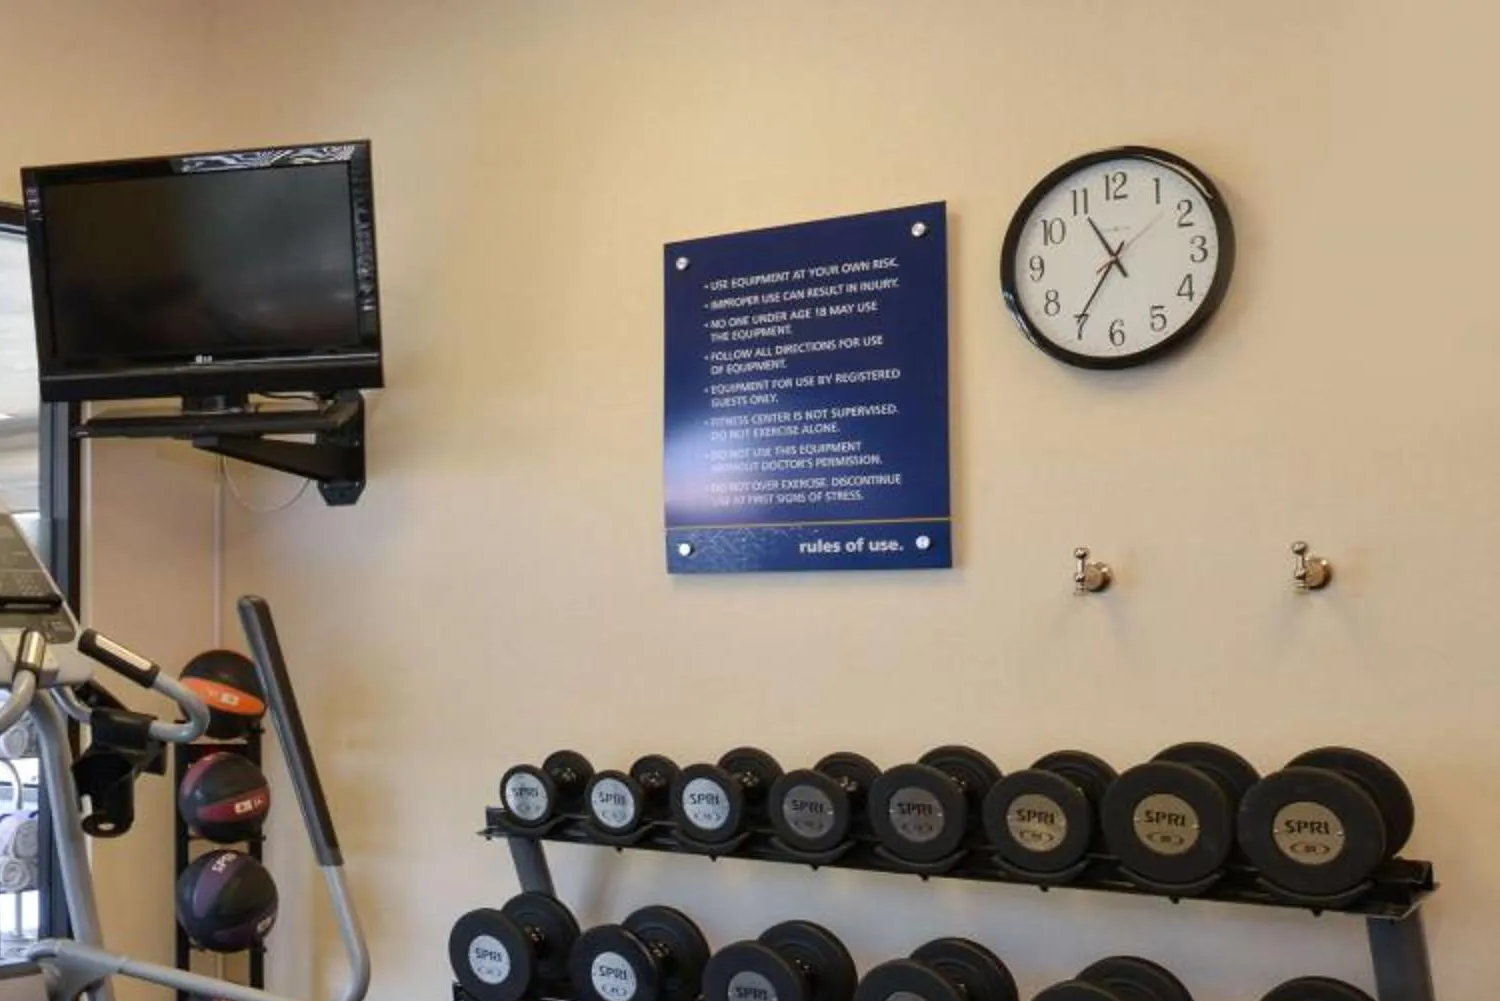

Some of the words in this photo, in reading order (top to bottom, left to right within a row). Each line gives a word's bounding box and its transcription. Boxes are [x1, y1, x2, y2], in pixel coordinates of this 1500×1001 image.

[1104, 171, 1128, 201] 12
[1153, 177, 1161, 204] 1
[1071, 187, 1088, 216] 11
[1177, 199, 1193, 228] 2
[1041, 217, 1066, 246] 10
[1190, 235, 1208, 263] 3
[710, 280, 728, 290] USE
[731, 271, 790, 288] EQUIPMENT
[792, 269, 805, 280] AT
[808, 265, 839, 277] YOUR
[841, 261, 870, 274] OWN
[1029, 255, 1044, 281] 9
[761, 292, 780, 304] USE
[783, 290, 805, 301] CAN
[807, 283, 844, 298] RESULT
[846, 283, 857, 293] IN
[1177, 273, 1195, 301] 4
[710, 319, 726, 329] NO
[728, 316, 750, 327] ONE
[751, 311, 787, 324] UNDER
[790, 309, 812, 320] AGE
[815, 307, 827, 317] 18
[829, 304, 855, 315] MAY
[857, 301, 879, 313] USE
[1044, 289, 1060, 316] 8
[1073, 313, 1089, 340] 7
[1150, 305, 1167, 332] 5
[1109, 319, 1125, 347] 6
[710, 348, 752, 361] FOLLOW
[754, 347, 772, 357] ALL
[775, 339, 836, 355] DIRECTIONS
[838, 337, 860, 349] FOR
[863, 335, 884, 346] USE
[710, 366, 724, 375] OF
[772, 378, 792, 388] FOR
[795, 375, 815, 387] USE
[817, 373, 833, 385] BY
[835, 368, 901, 383] REGISTERED
[749, 393, 779, 405] ONLY.
[751, 412, 791, 424] CENTER
[793, 411, 803, 420] IS
[805, 408, 828, 420] NOT
[774, 445, 796, 455] THIS
[799, 441, 862, 454] EQUIPMENT
[832, 473, 901, 486] DISCONTINUE
[808, 491, 822, 503] OF
[800, 538, 840, 553] rules
[845, 537, 864, 552] of
[868, 540, 904, 552] use.
[689, 793, 720, 806] SPRI
[1016, 808, 1055, 825] SPRI
[1144, 810, 1185, 827] SPRI
[1284, 819, 1330, 834] SPRI
